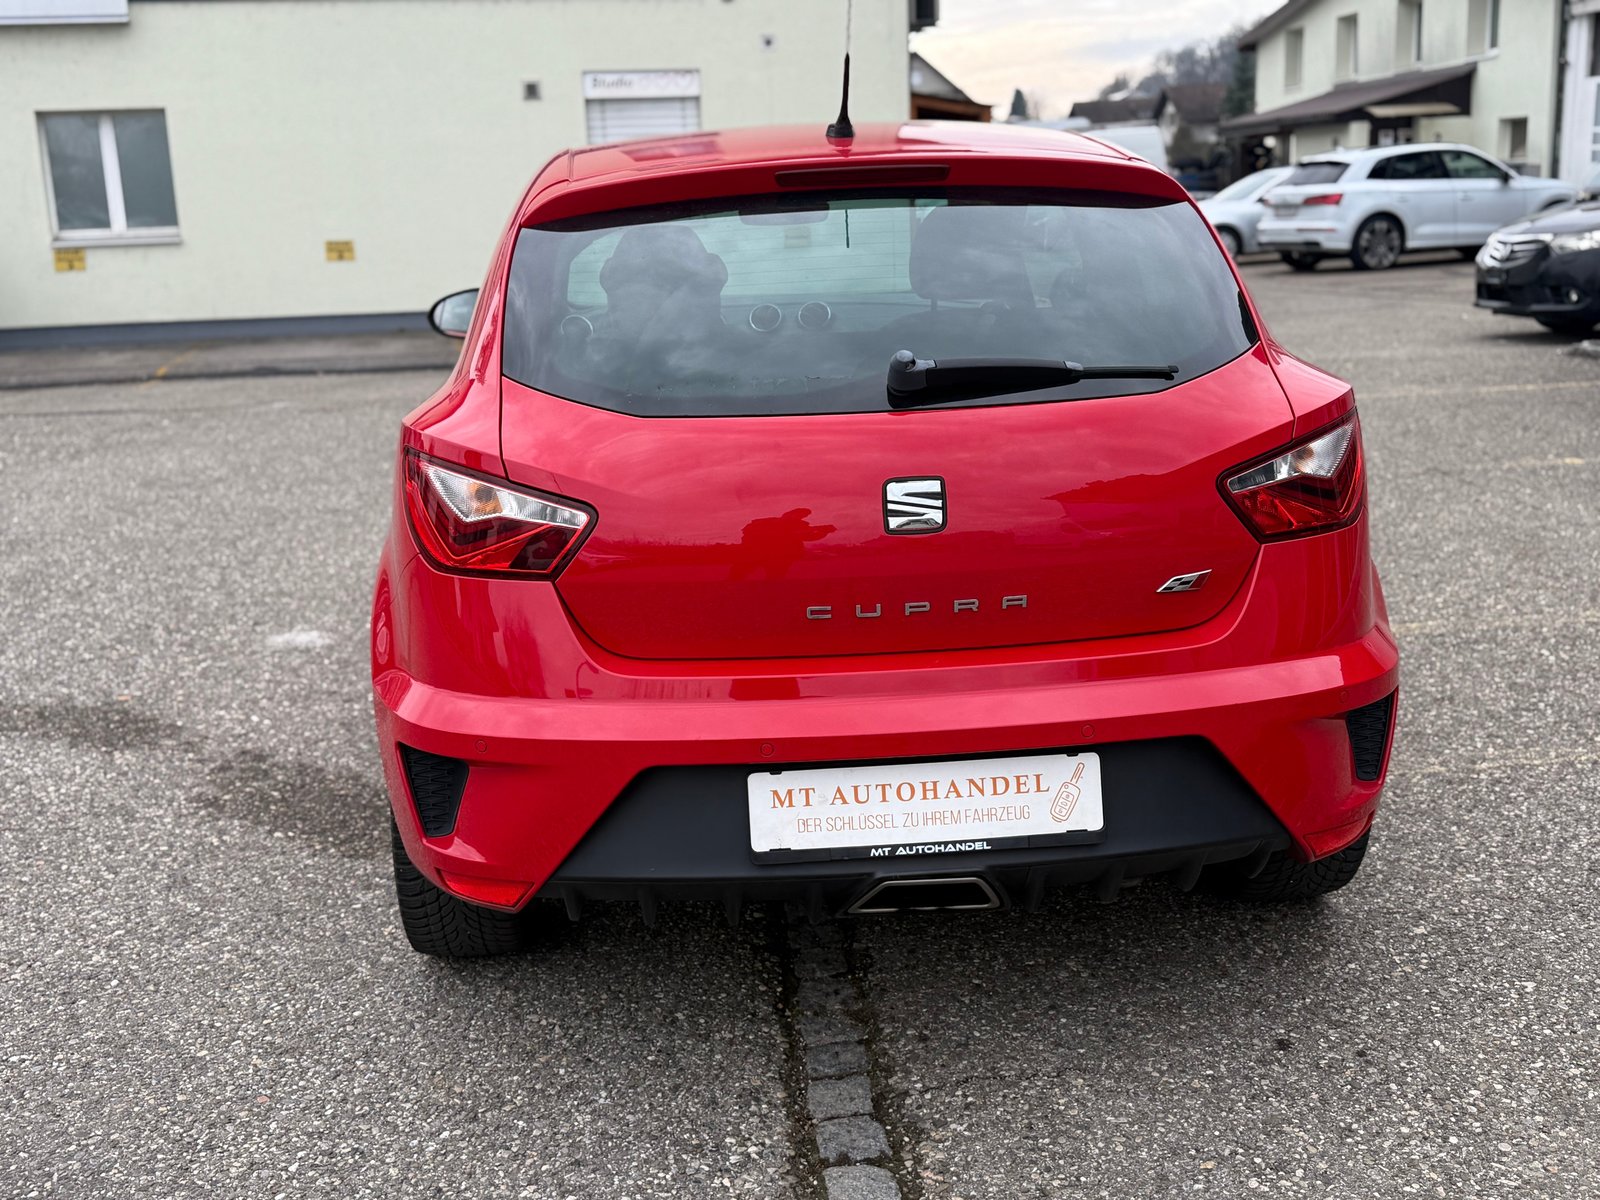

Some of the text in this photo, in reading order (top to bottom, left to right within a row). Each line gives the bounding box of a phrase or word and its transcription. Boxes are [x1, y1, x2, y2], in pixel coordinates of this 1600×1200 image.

[806, 594, 1028, 620] CUPRA
[770, 773, 1050, 809] MT AUTOHANDEL
[796, 804, 1031, 834] DER SCHLÜSSEL ZU IHREM FAHRZEUG
[869, 841, 992, 857] MT AUTOHANDEL
